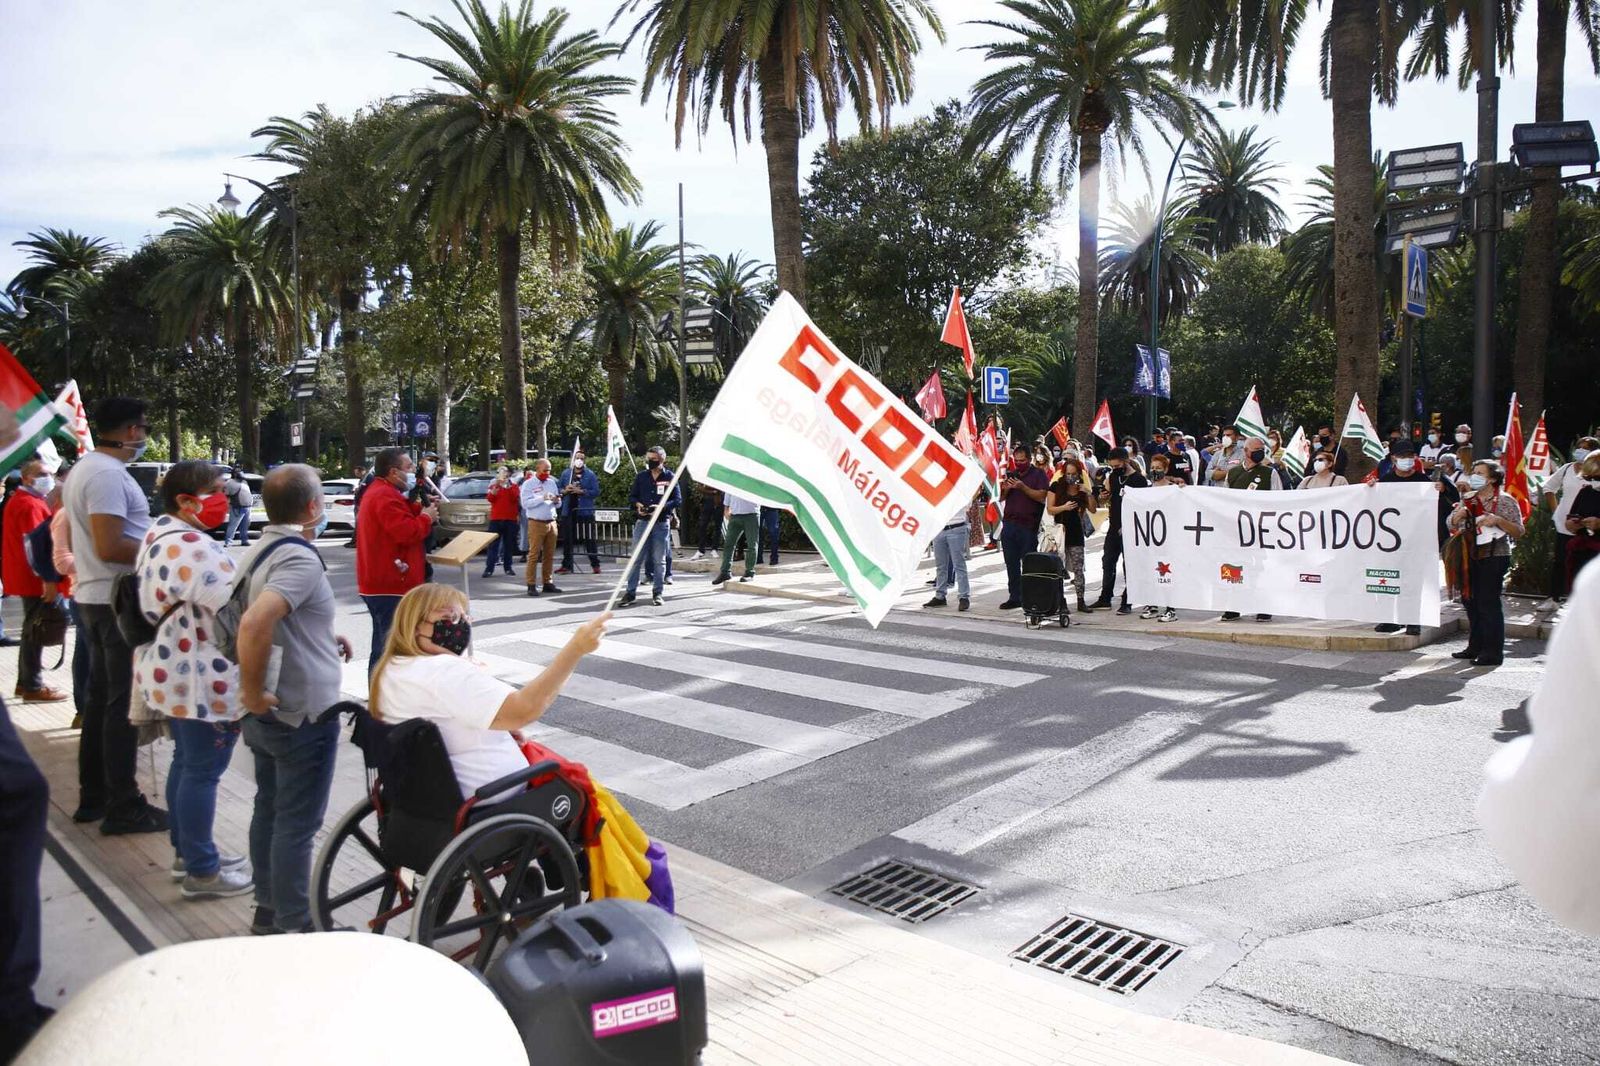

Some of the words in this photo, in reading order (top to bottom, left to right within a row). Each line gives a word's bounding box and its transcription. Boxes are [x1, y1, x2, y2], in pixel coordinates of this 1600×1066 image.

[991, 371, 1005, 399] P
[778, 324, 966, 508] CCOO
[837, 448, 920, 536] Málaga
[1134, 510, 1167, 546] NO
[1238, 508, 1402, 552] DESPIDOS
[622, 999, 671, 1020] CCOO
